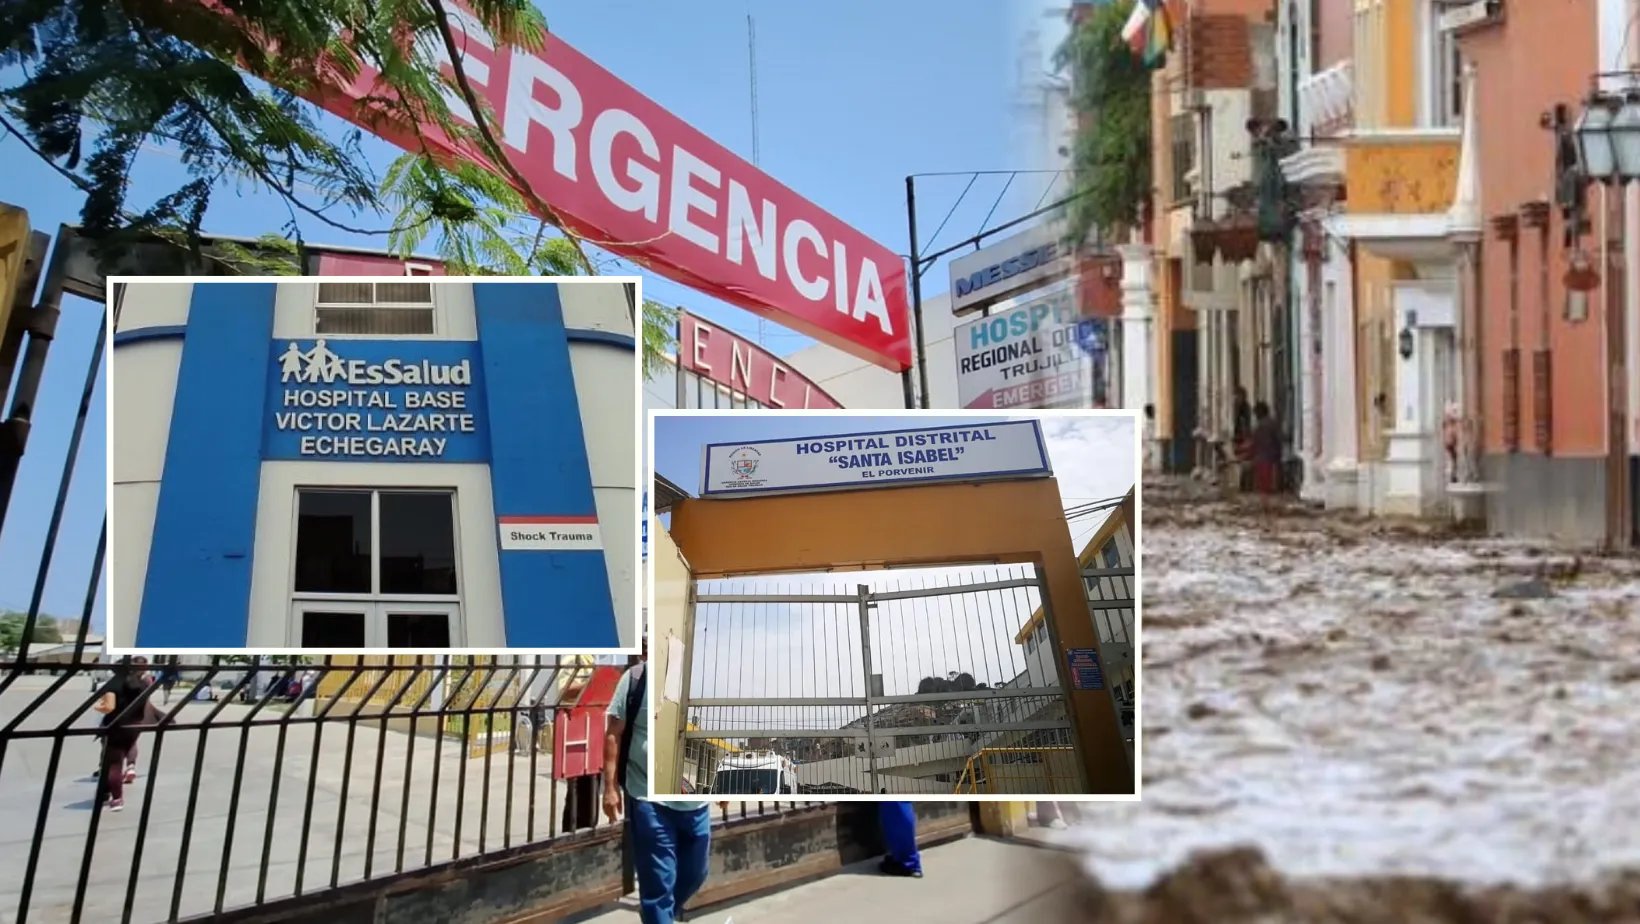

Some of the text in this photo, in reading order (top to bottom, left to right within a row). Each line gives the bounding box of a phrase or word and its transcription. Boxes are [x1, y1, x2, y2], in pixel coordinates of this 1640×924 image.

[408, 0, 893, 335] ERGENCIA
[961, 337, 1043, 375] REGIONAL
[1000, 348, 1081, 381] TRUJILL
[348, 359, 472, 386] EsSalud
[284, 389, 467, 409] HOSPITAL BASE
[275, 412, 475, 432] VICTOR LAZARTE
[300, 436, 447, 456] ECHEGARAY
[796, 429, 997, 455] HOSPITAL DISTRITAL
[878, 466, 935, 477] PORVENIR
[510, 531, 593, 541] Shock Trauma
